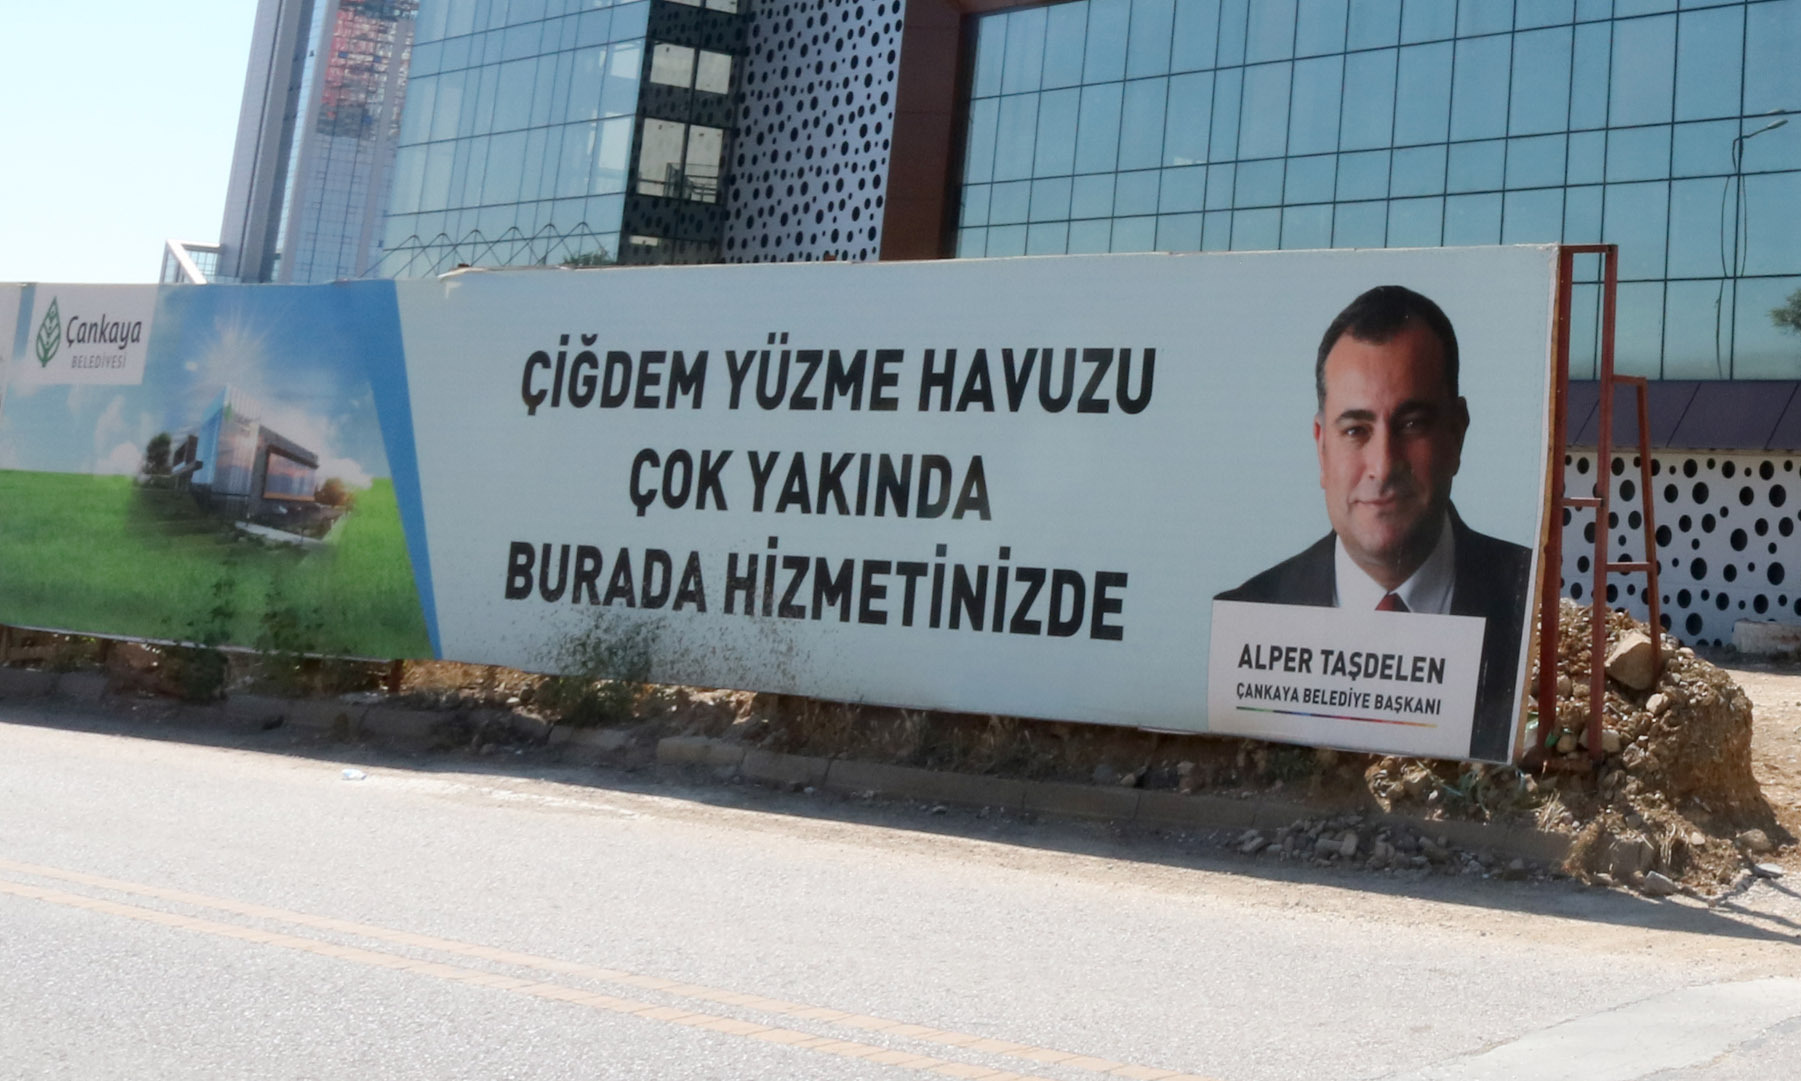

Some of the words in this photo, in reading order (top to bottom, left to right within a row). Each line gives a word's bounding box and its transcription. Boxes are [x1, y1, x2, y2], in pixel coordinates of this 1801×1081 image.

[66, 314, 142, 350] Çankaya
[71, 353, 127, 369] BELEDİYESİ
[521, 333, 709, 417] ÇİĞDEM
[725, 331, 904, 412] YÜZME
[918, 347, 1156, 415] HAVUZU
[629, 448, 734, 517] ÇOK
[747, 450, 992, 521] YAKINDA
[504, 541, 708, 614] BURADA
[723, 535, 1129, 642] HİZMETİNİZDE
[1238, 643, 1313, 674] ALPER
[1320, 649, 1446, 685] TAŞDELEN
[1236, 682, 1300, 704] ÇANKAYA
[1302, 687, 1370, 708] BELEDİYE
[1373, 695, 1441, 716] BAŞKANI
